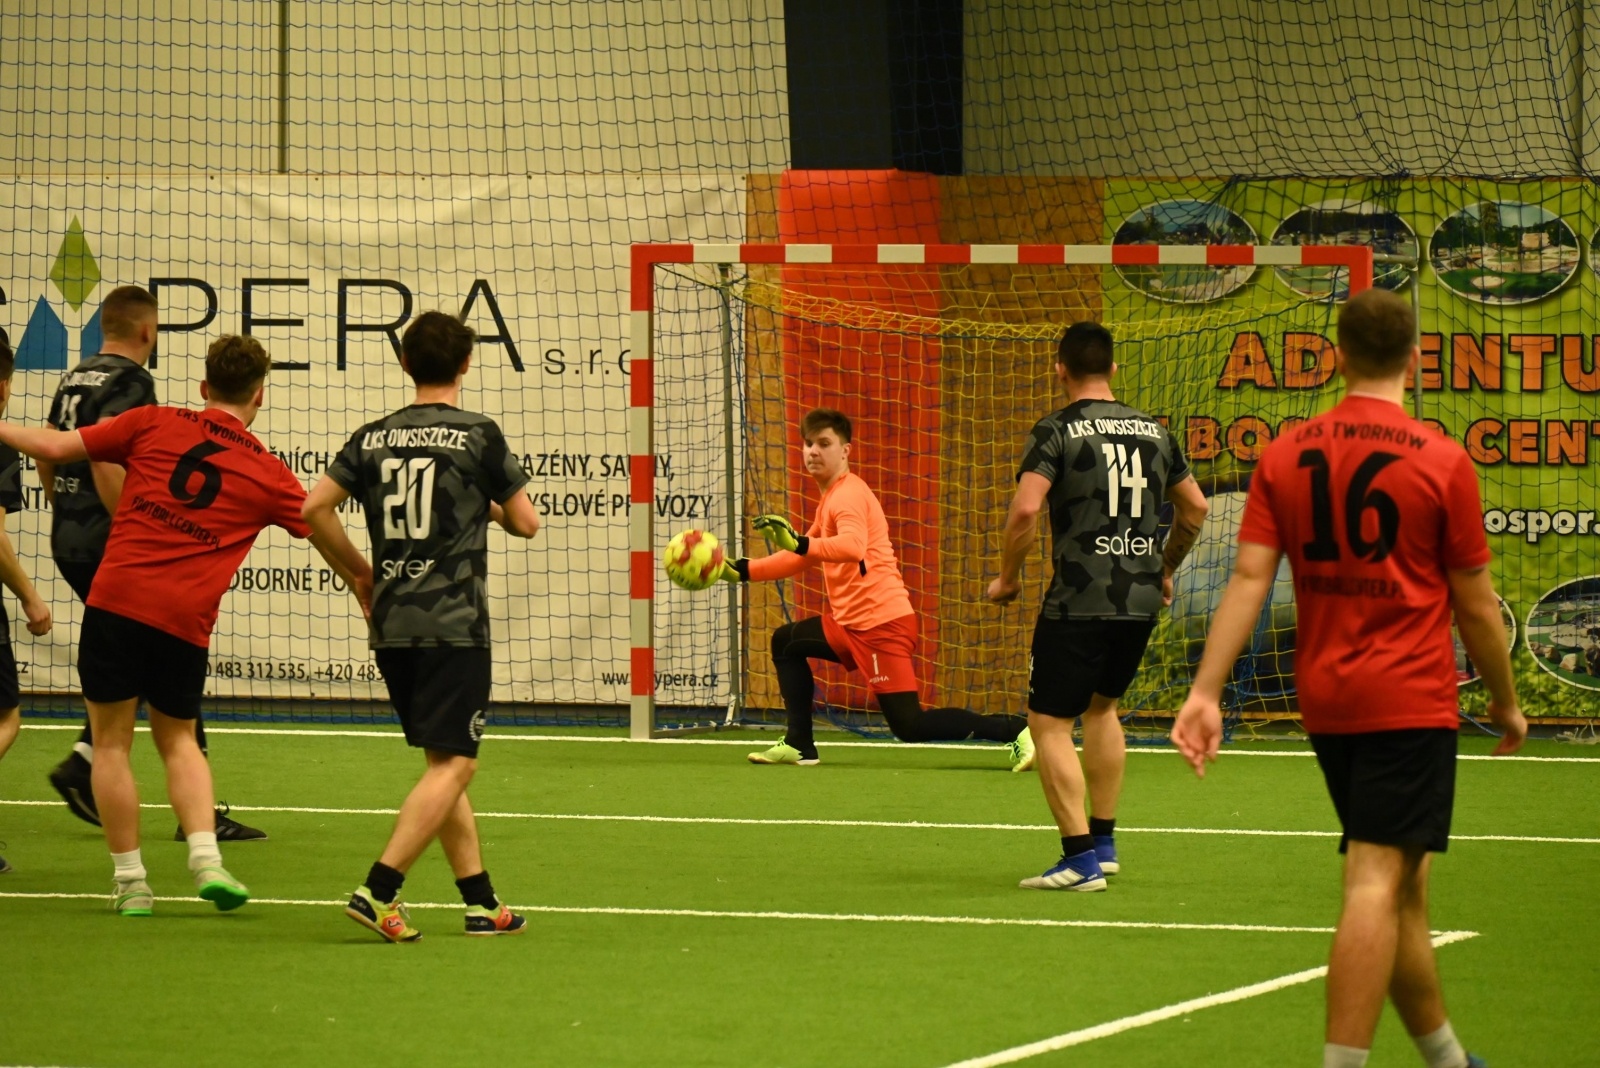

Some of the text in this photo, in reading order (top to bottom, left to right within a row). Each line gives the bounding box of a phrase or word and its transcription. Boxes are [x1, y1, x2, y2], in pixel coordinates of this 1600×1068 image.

[177, 408, 199, 423] LKS
[361, 427, 469, 451] LKS OWSISZCZE
[1066, 419, 1095, 439] LKS
[1094, 418, 1161, 440] OWSISZCZE
[1294, 422, 1324, 444] LKS
[168, 439, 232, 510] 6
[1101, 443, 1148, 518] 14
[380, 457, 436, 540] 20
[1297, 447, 1405, 564] 16
[1095, 527, 1155, 557] safer
[216, 662, 243, 681] 483
[247, 662, 274, 680] 312
[278, 662, 310, 682] 535,
[314, 663, 353, 680] +420
[872, 653, 879, 675] 1
